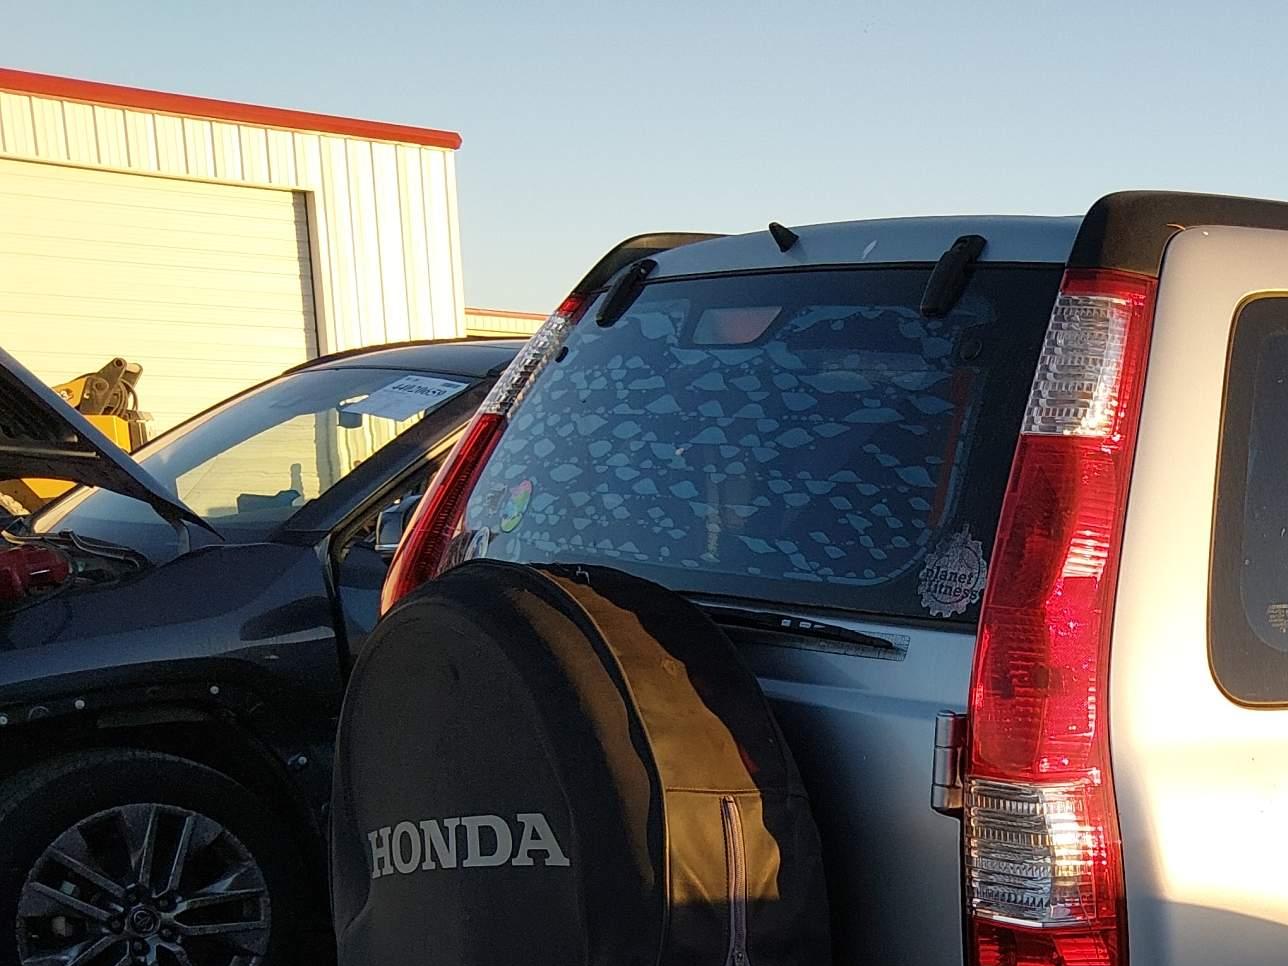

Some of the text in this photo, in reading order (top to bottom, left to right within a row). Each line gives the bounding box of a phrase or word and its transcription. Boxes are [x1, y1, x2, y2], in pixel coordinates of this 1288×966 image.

[926, 566, 974, 585] planet
[926, 581, 979, 601] fitness
[367, 812, 570, 880] HONDA
